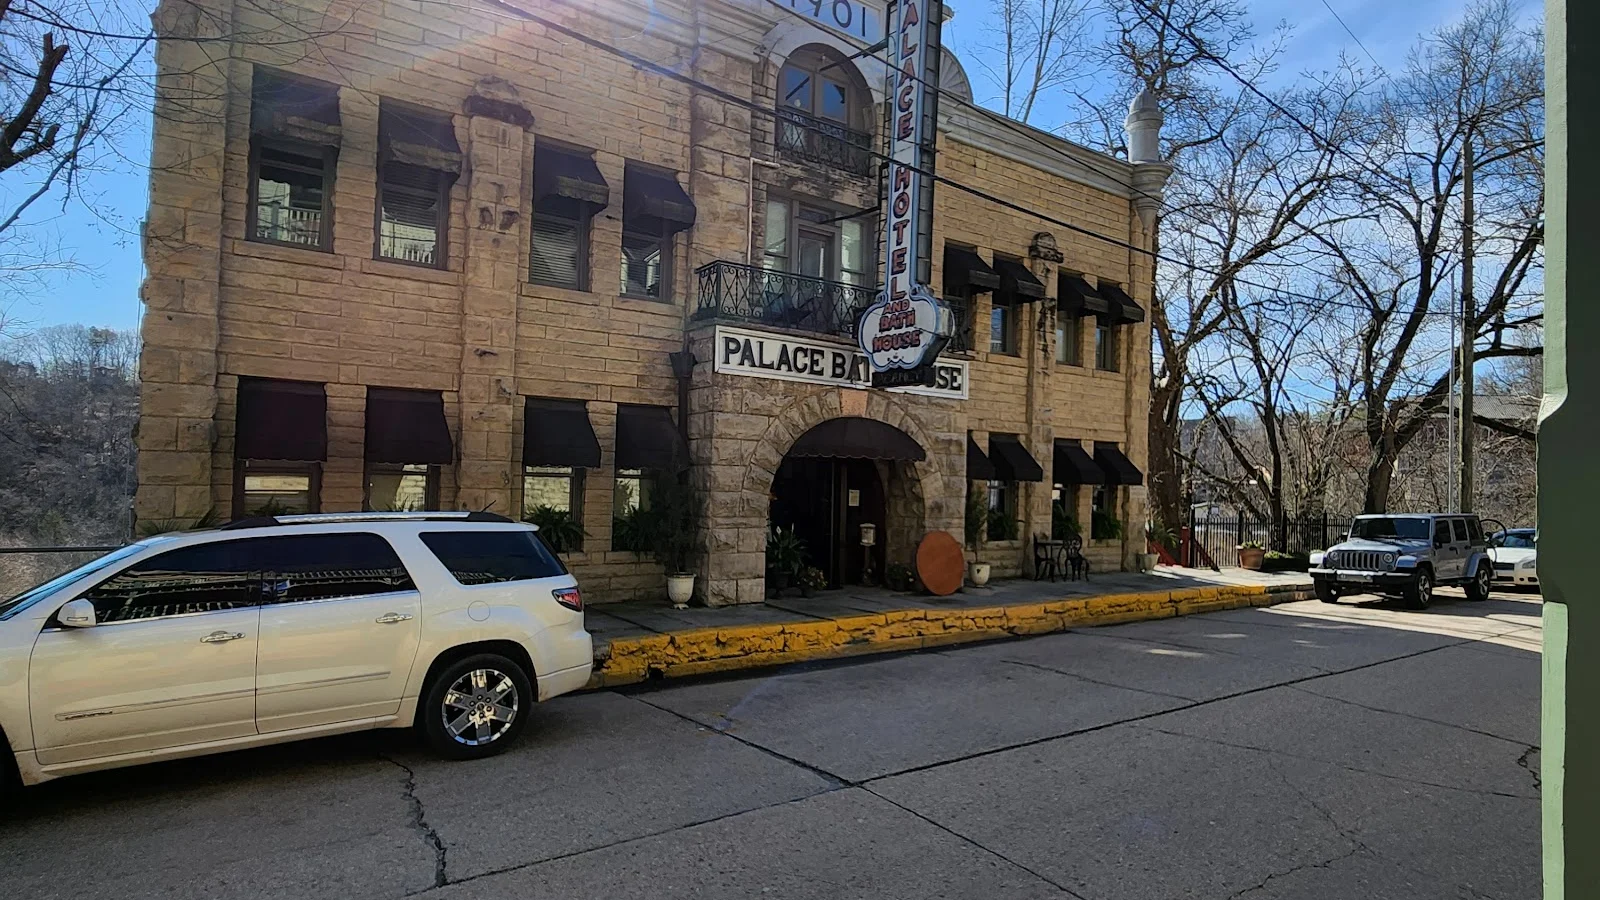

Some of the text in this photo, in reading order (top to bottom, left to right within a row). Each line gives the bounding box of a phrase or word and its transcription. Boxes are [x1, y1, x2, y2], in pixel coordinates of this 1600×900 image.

[789, 0, 866, 37] 901
[890, 0, 919, 300] ALACE HOTEL
[879, 309, 916, 332] BATH
[882, 299, 910, 316] AND
[872, 330, 922, 353] HOUSE
[722, 336, 825, 376] PALACE
[830, 351, 871, 383] BAT
